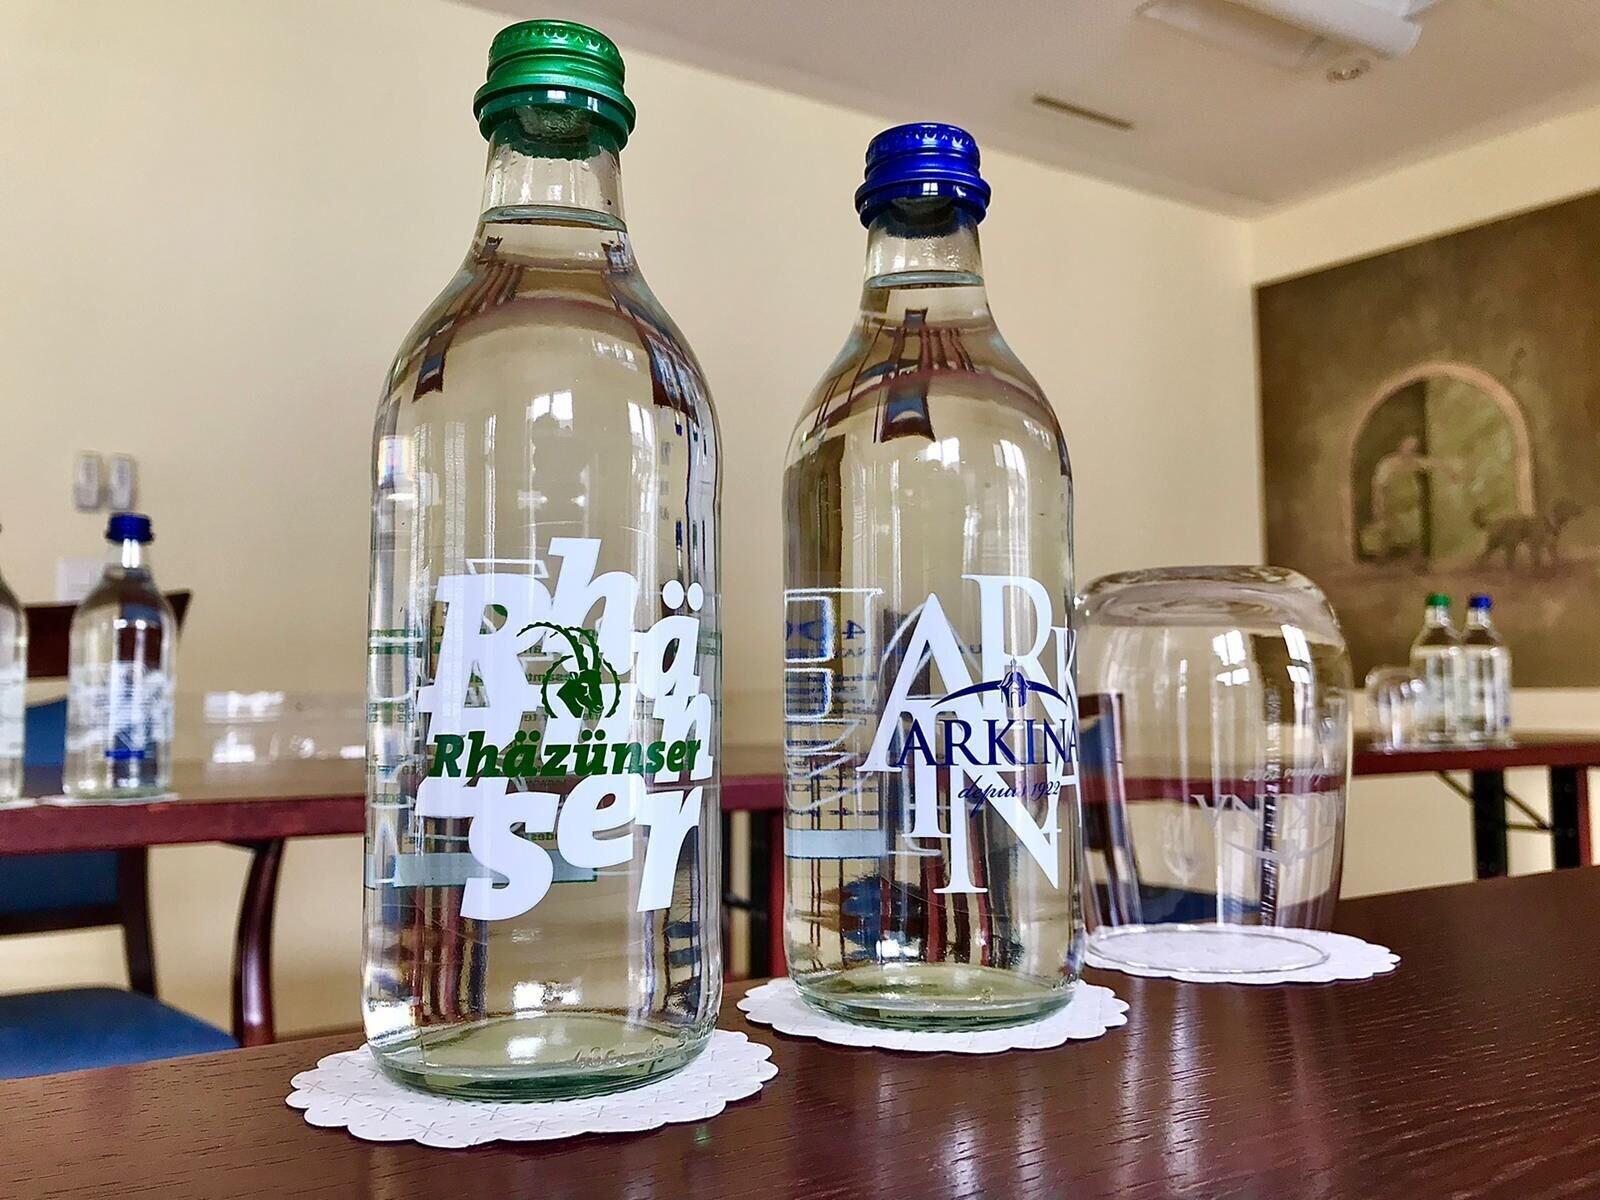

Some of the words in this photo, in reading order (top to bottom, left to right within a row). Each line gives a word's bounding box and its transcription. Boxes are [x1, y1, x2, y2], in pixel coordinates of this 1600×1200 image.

[428, 728, 702, 778] Rhäzünser
[899, 717, 1080, 767] ARKINA
[957, 774, 1027, 818] depuis
[1031, 780, 1061, 801] 1922
